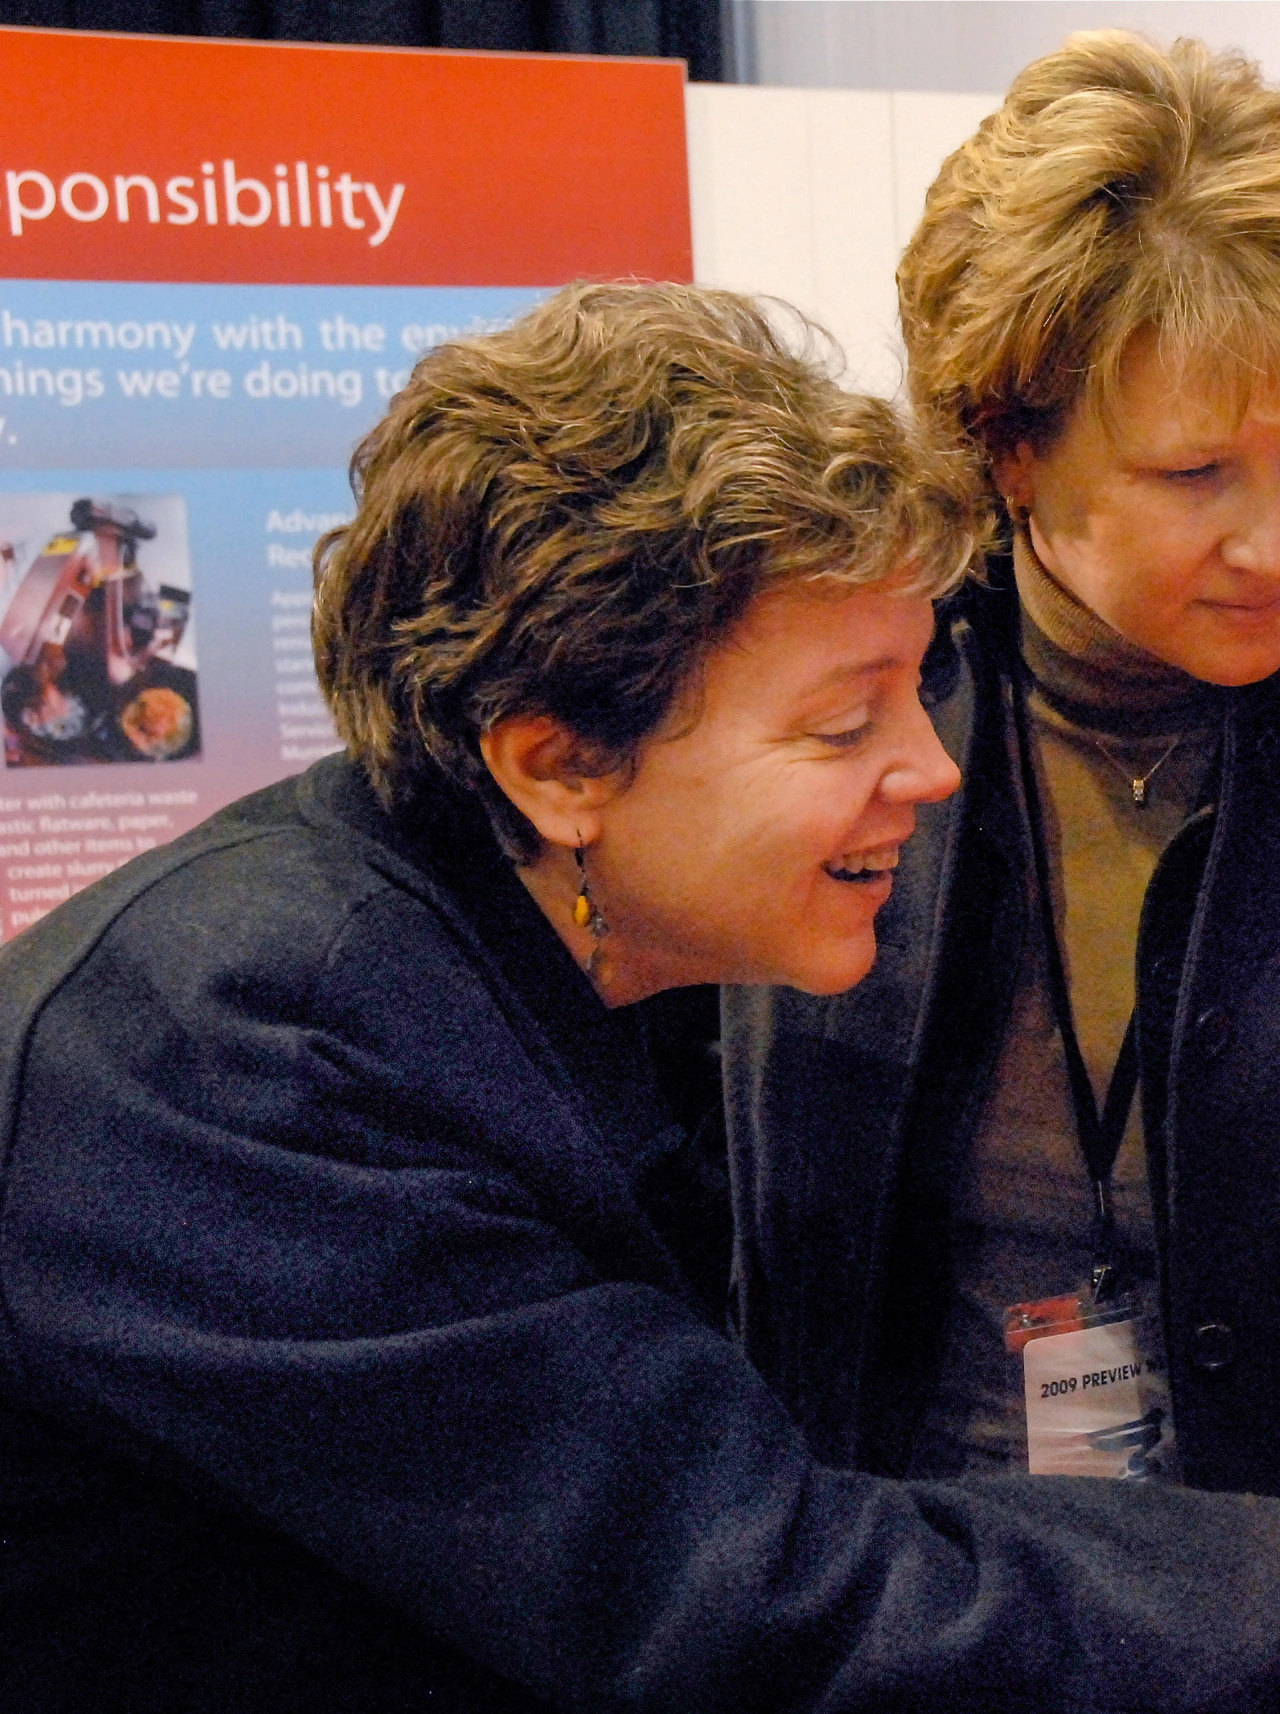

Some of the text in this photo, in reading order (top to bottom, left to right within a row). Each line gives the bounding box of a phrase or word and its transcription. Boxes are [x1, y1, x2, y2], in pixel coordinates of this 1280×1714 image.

[7, 159, 405, 247] ponsibility
[3, 310, 196, 360] harmony
[213, 313, 303, 352] with
[320, 314, 386, 352] the
[117, 362, 231, 399] we're
[245, 362, 363, 408] doing
[8, 864, 63, 880] create
[1040, 1377, 1078, 1399] 2009
[1082, 1363, 1142, 1390] PREVIEW
